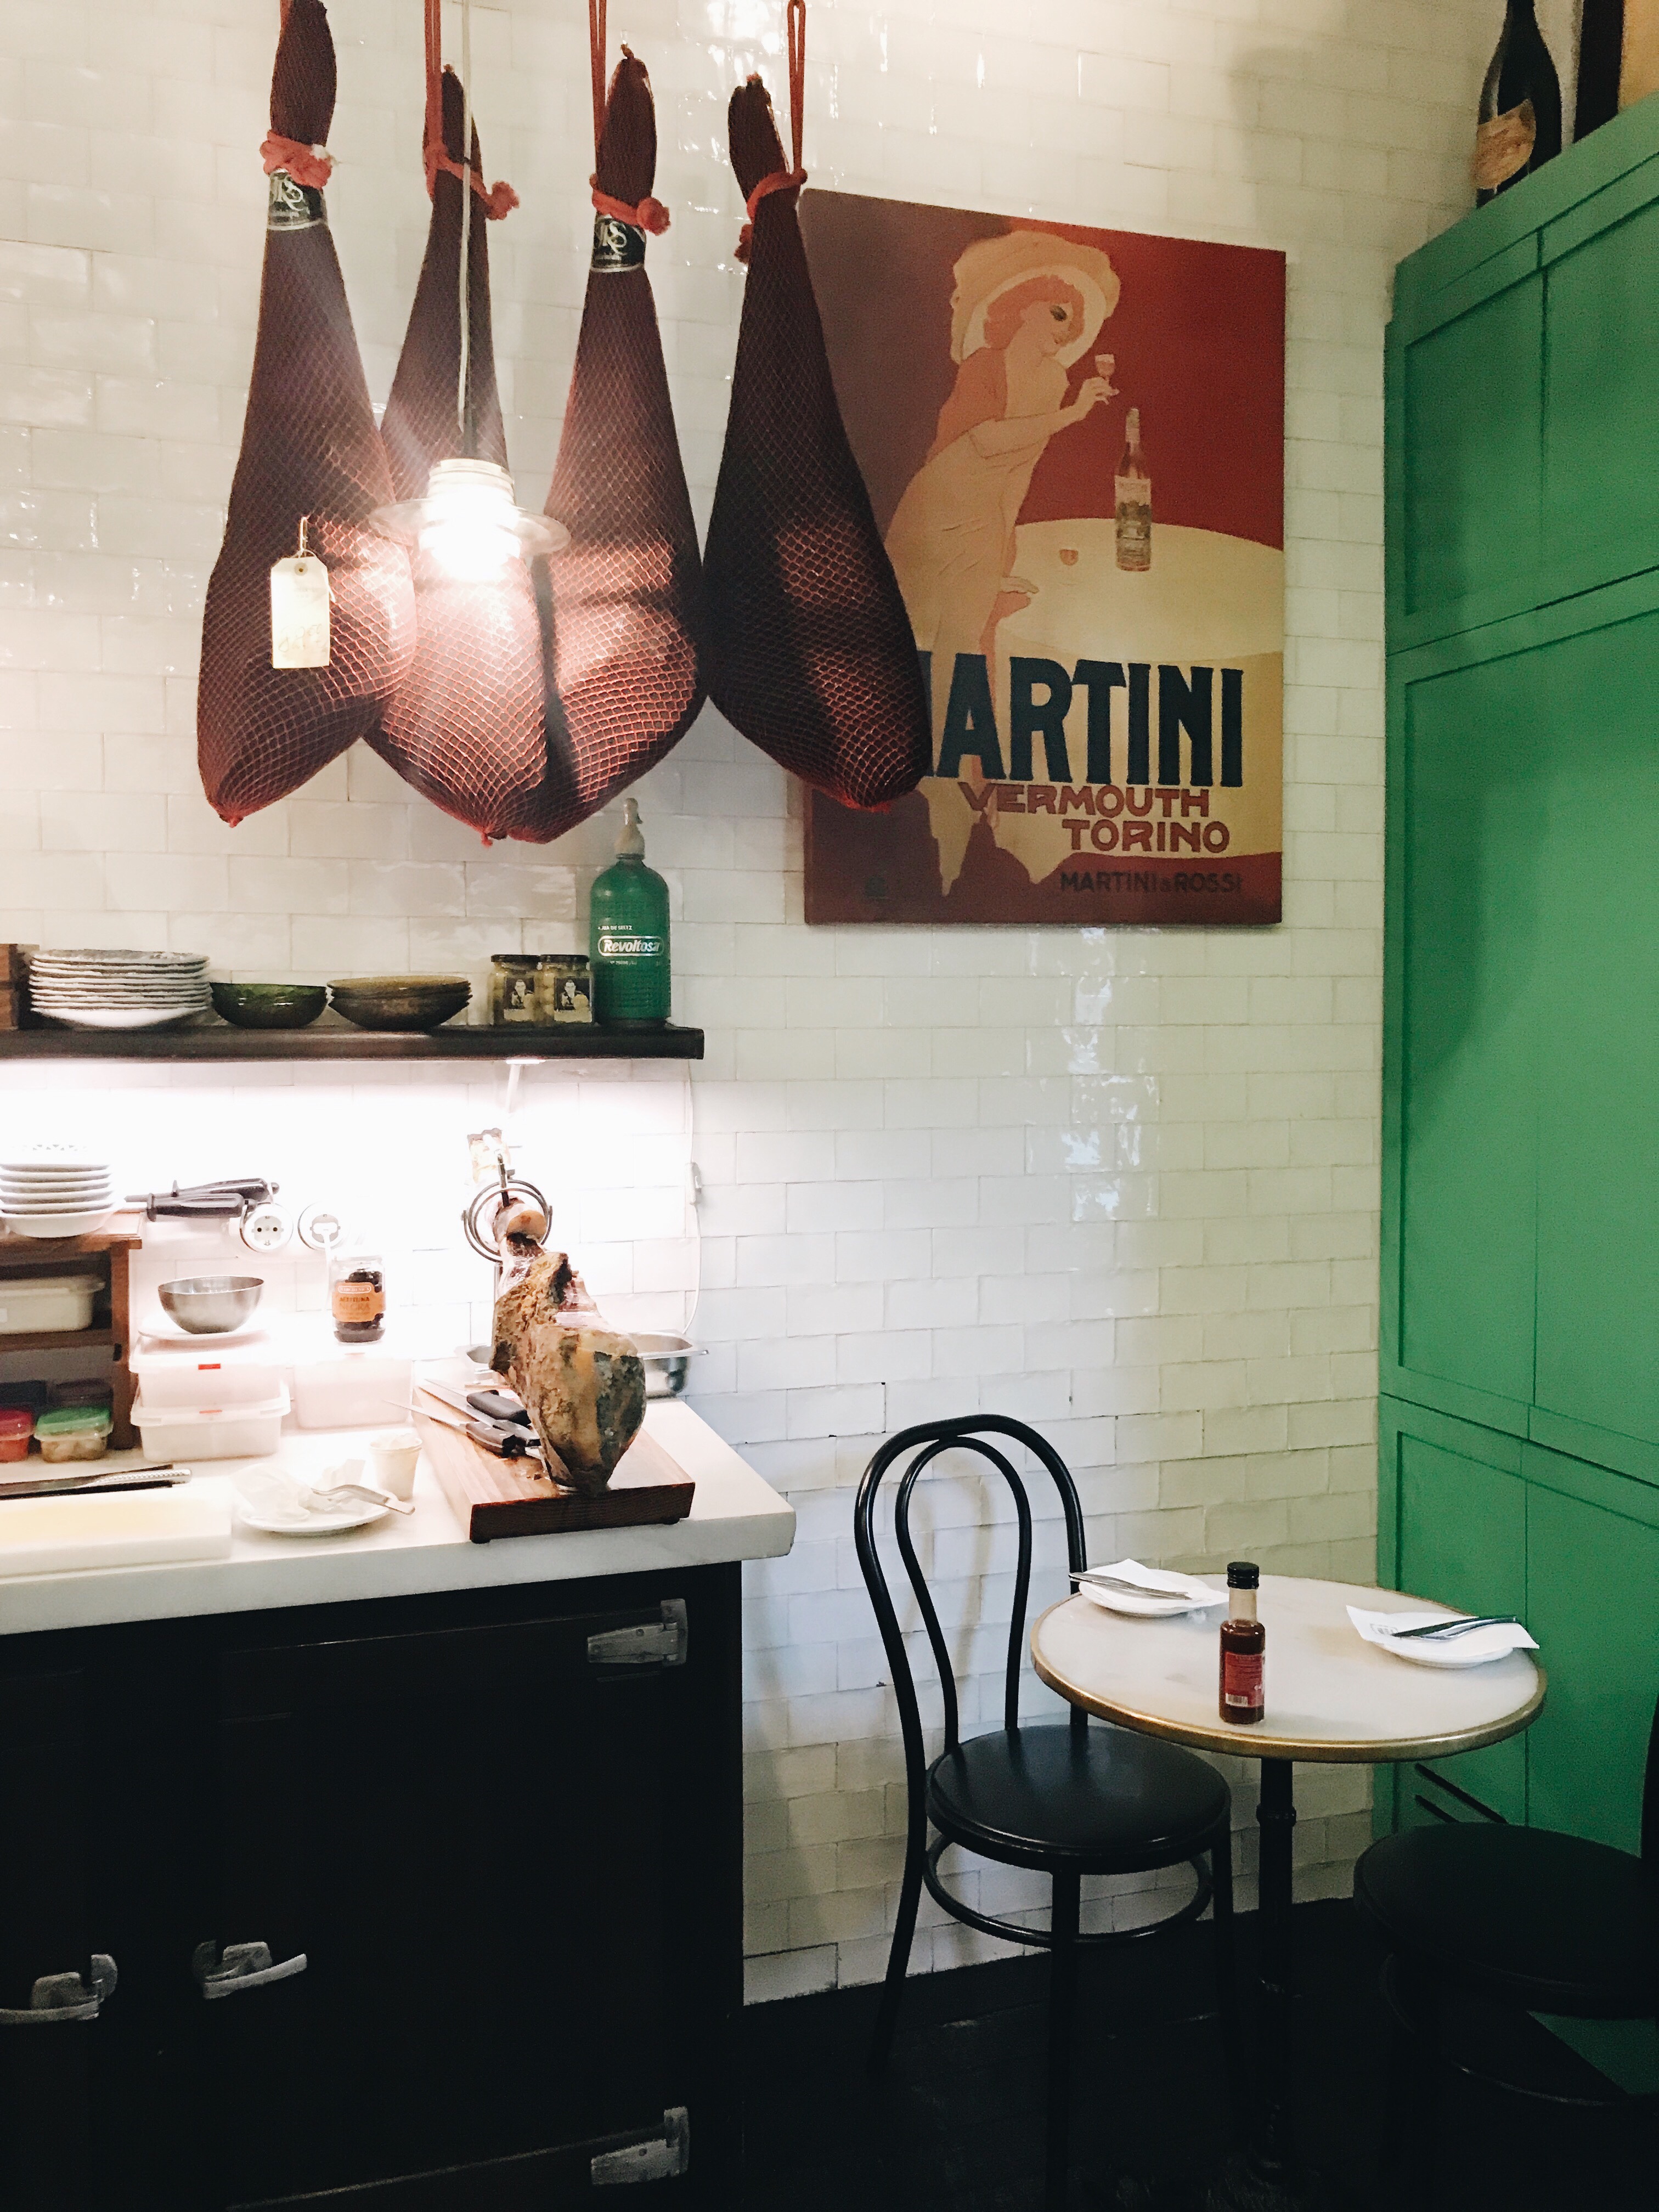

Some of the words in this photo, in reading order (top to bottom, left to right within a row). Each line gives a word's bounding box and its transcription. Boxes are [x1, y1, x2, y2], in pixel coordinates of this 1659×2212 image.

[917, 651, 1243, 787] ARTINI
[958, 781, 1209, 818] VERMOUTH
[1062, 819, 1231, 853] TORINO
[603, 939, 661, 952] Revoltosa
